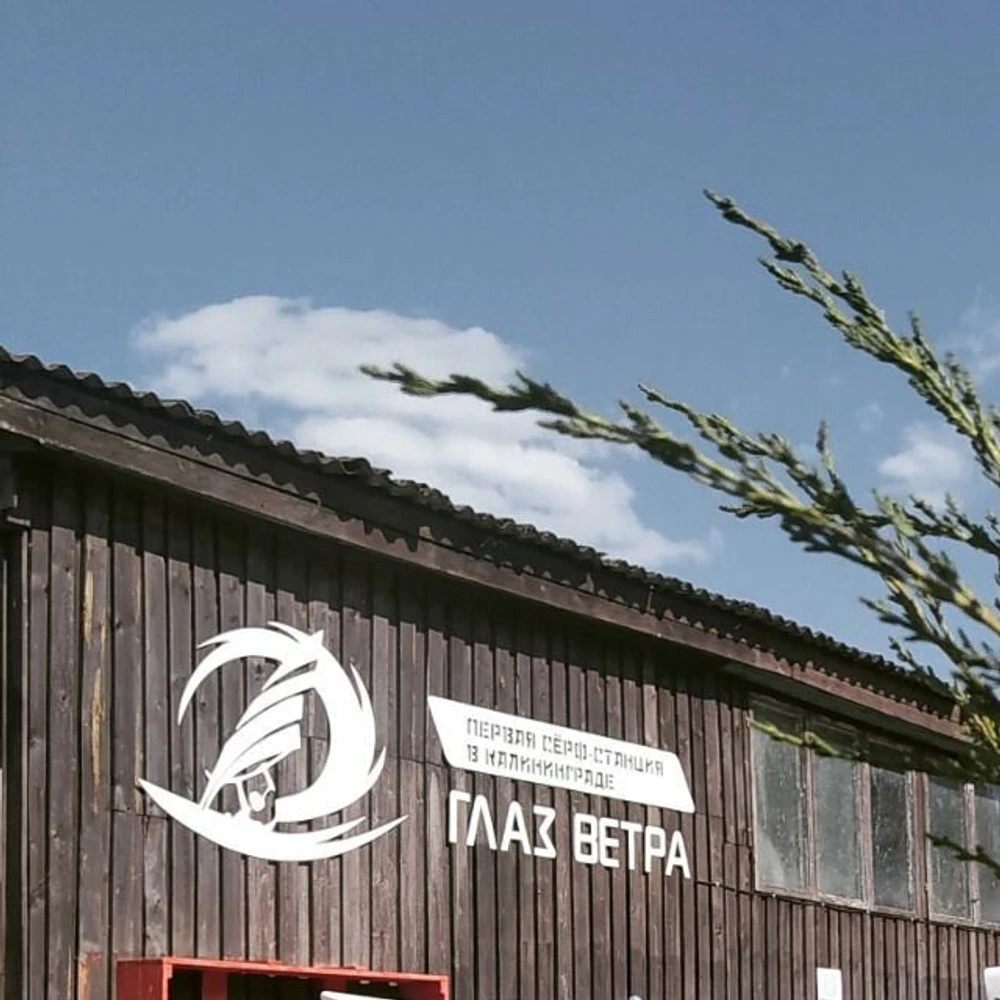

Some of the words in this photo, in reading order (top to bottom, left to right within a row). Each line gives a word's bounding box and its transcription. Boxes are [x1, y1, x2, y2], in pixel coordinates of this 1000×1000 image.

[467, 717, 536, 749] ПЕРВАЯ
[486, 748, 616, 791] КАЛИНИНГРАДЕ
[449, 789, 557, 859] ГЛАЗ
[573, 812, 692, 879] ВЕТРА
